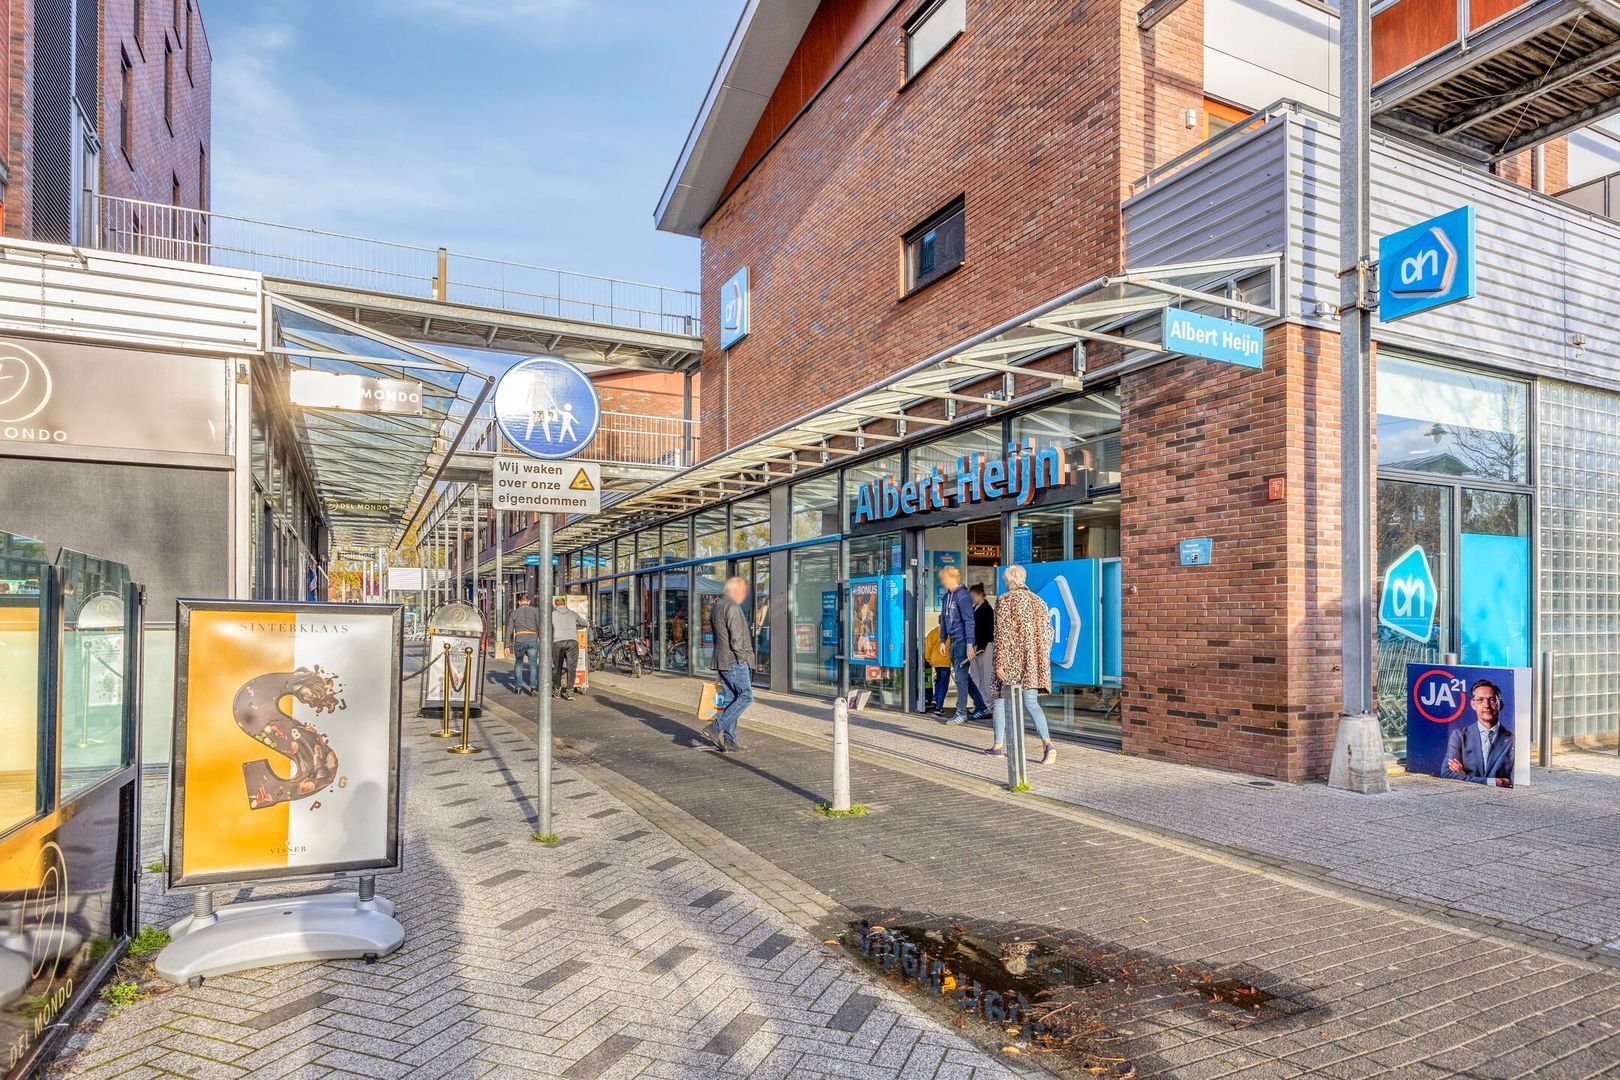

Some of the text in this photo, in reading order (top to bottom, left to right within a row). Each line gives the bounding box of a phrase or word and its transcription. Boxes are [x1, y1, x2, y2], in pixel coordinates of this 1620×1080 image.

[1170, 320, 1259, 356] Albert Heijn
[361, 388, 420, 403] MONDO
[4, 427, 67, 442] ONDO
[499, 461, 563, 475] Wij waken
[498, 479, 561, 490] over onze
[855, 437, 1066, 524] Albert Heijn
[498, 493, 587, 507] eigendommen
[857, 584, 878, 595] BONUS
[240, 623, 349, 633] SINTERKLAAS
[10, 978, 73, 1069] DEL MONDO
